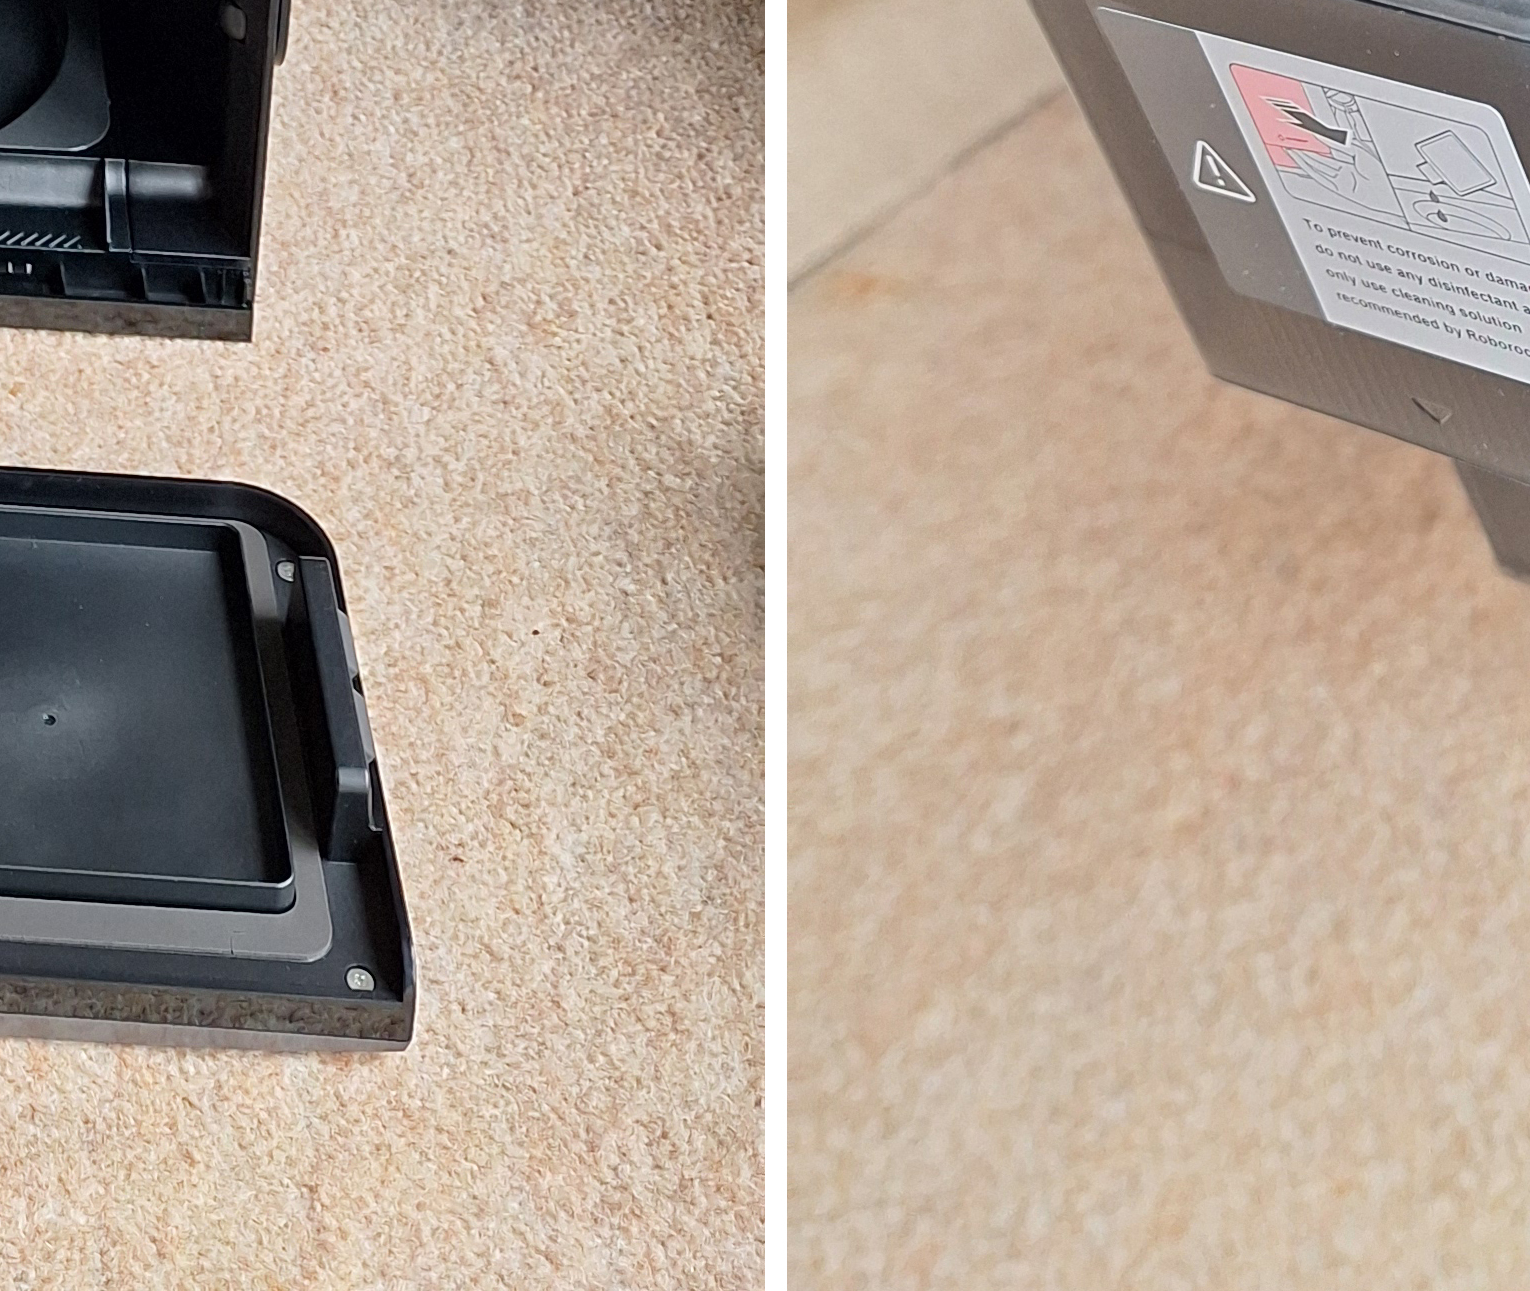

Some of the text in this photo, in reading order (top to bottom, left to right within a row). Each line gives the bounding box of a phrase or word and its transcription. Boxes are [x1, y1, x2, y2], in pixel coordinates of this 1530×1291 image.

[1302, 217, 1323, 232] To
[1326, 227, 1383, 250] prevent
[1386, 244, 1460, 272] corrosion
[1463, 267, 1481, 279] or
[1314, 243, 1333, 256] do
[1337, 251, 1363, 265] not
[1365, 259, 1392, 274] use
[1396, 268, 1422, 285] any
[1427, 276, 1519, 311] disinfectant
[1325, 268, 1522, 333] only use cleaning solution
[1336, 292, 1440, 329] recommended
[1442, 321, 1461, 338] by
